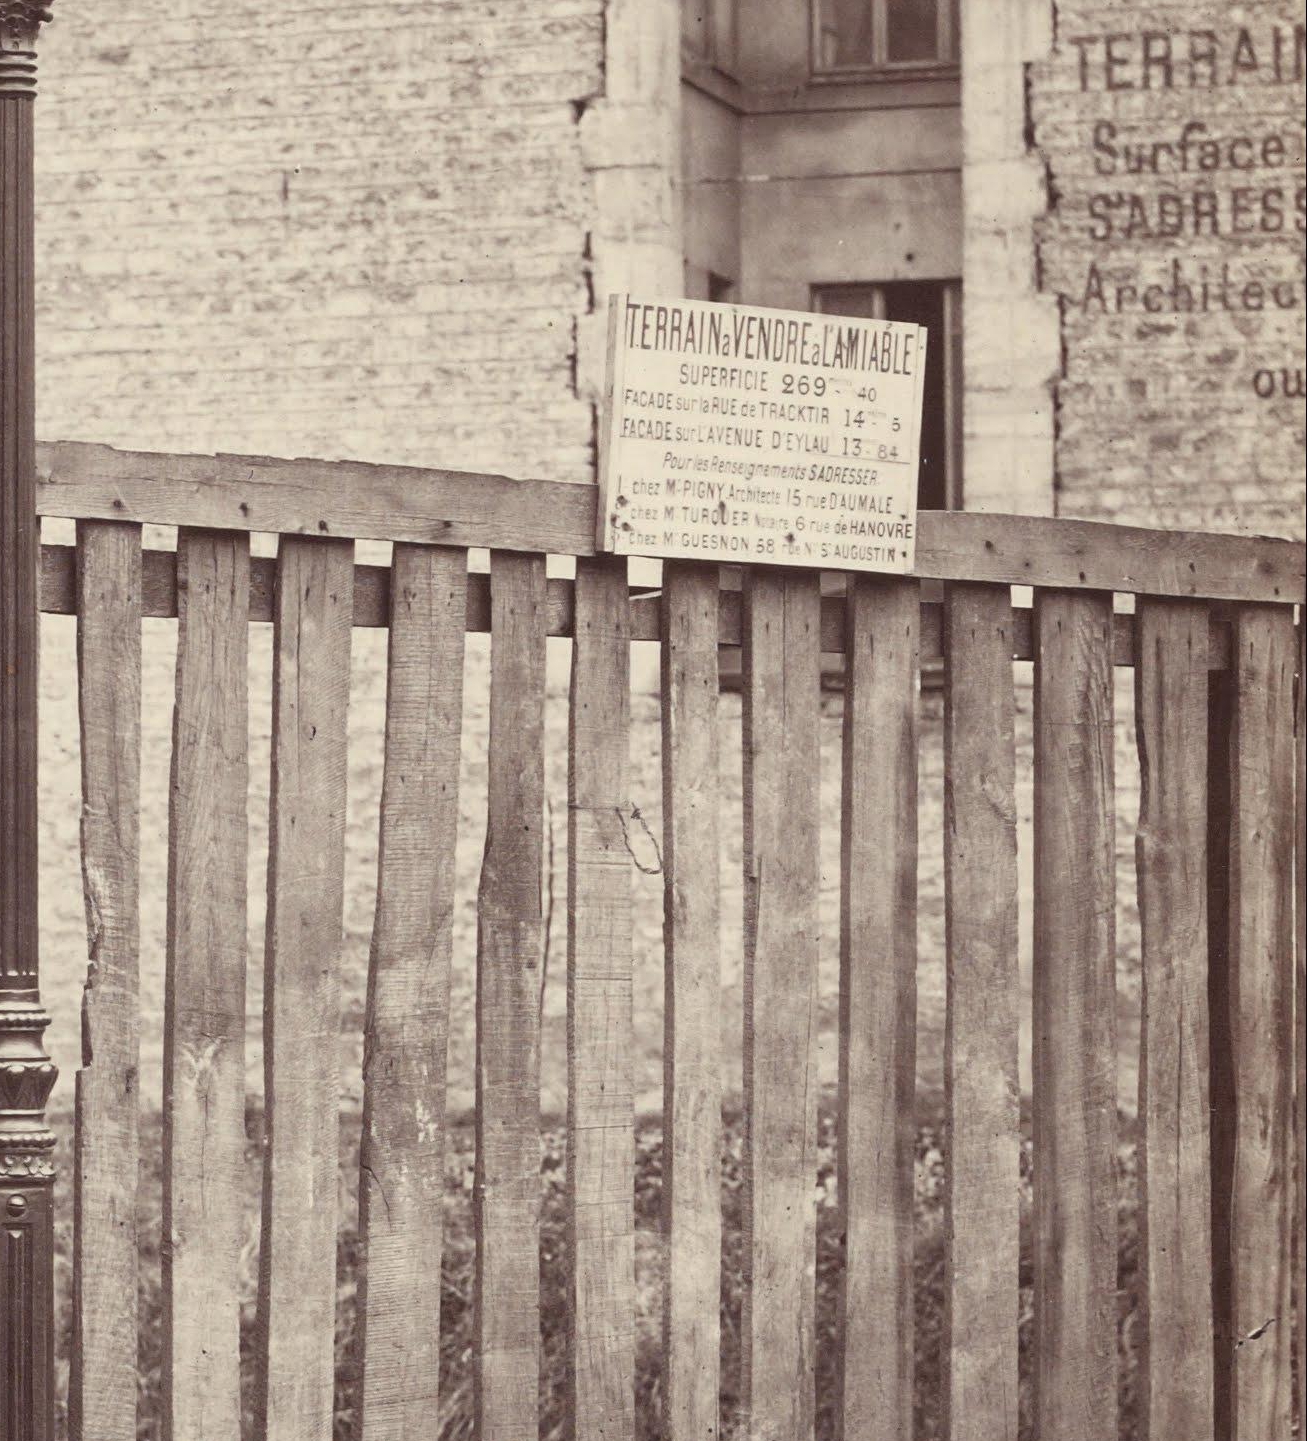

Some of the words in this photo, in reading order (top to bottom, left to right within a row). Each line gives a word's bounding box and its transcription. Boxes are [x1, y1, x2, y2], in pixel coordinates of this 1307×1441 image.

[1094, 119, 1285, 176] Surface
[626, 303, 722, 356] TERRAIN
[733, 313, 812, 366] VENDRE
[822, 324, 914, 376] L'AMIABLE
[679, 363, 768, 392] SUPERFICIE
[782, 374, 826, 397] 269
[624, 389, 673, 410] FACADE
[676, 396, 698, 411] sur
[700, 396, 709, 413] la
[712, 396, 737, 416] RUE
[741, 398, 755, 418] de
[759, 401, 829, 425] TRACKTIR
[844, 409, 865, 428] 14
[623, 418, 673, 441] FACADE
[675, 426, 697, 442] sur
[842, 437, 862, 456] 13
[663, 452, 693, 469] Pour
[693, 457, 708, 472] les
[711, 455, 807, 480] Renseignements
[632, 478, 661, 496] chez
[683, 479, 725, 499] PIGNY
[806, 495, 827, 509] rue
[631, 507, 659, 521] chez
[810, 519, 830, 533] rue
[834, 520, 847, 535] de
[849, 519, 913, 539] HANOVRE
[681, 533, 749, 551] GUESNON
[834, 544, 896, 563] AUGUSTIN
